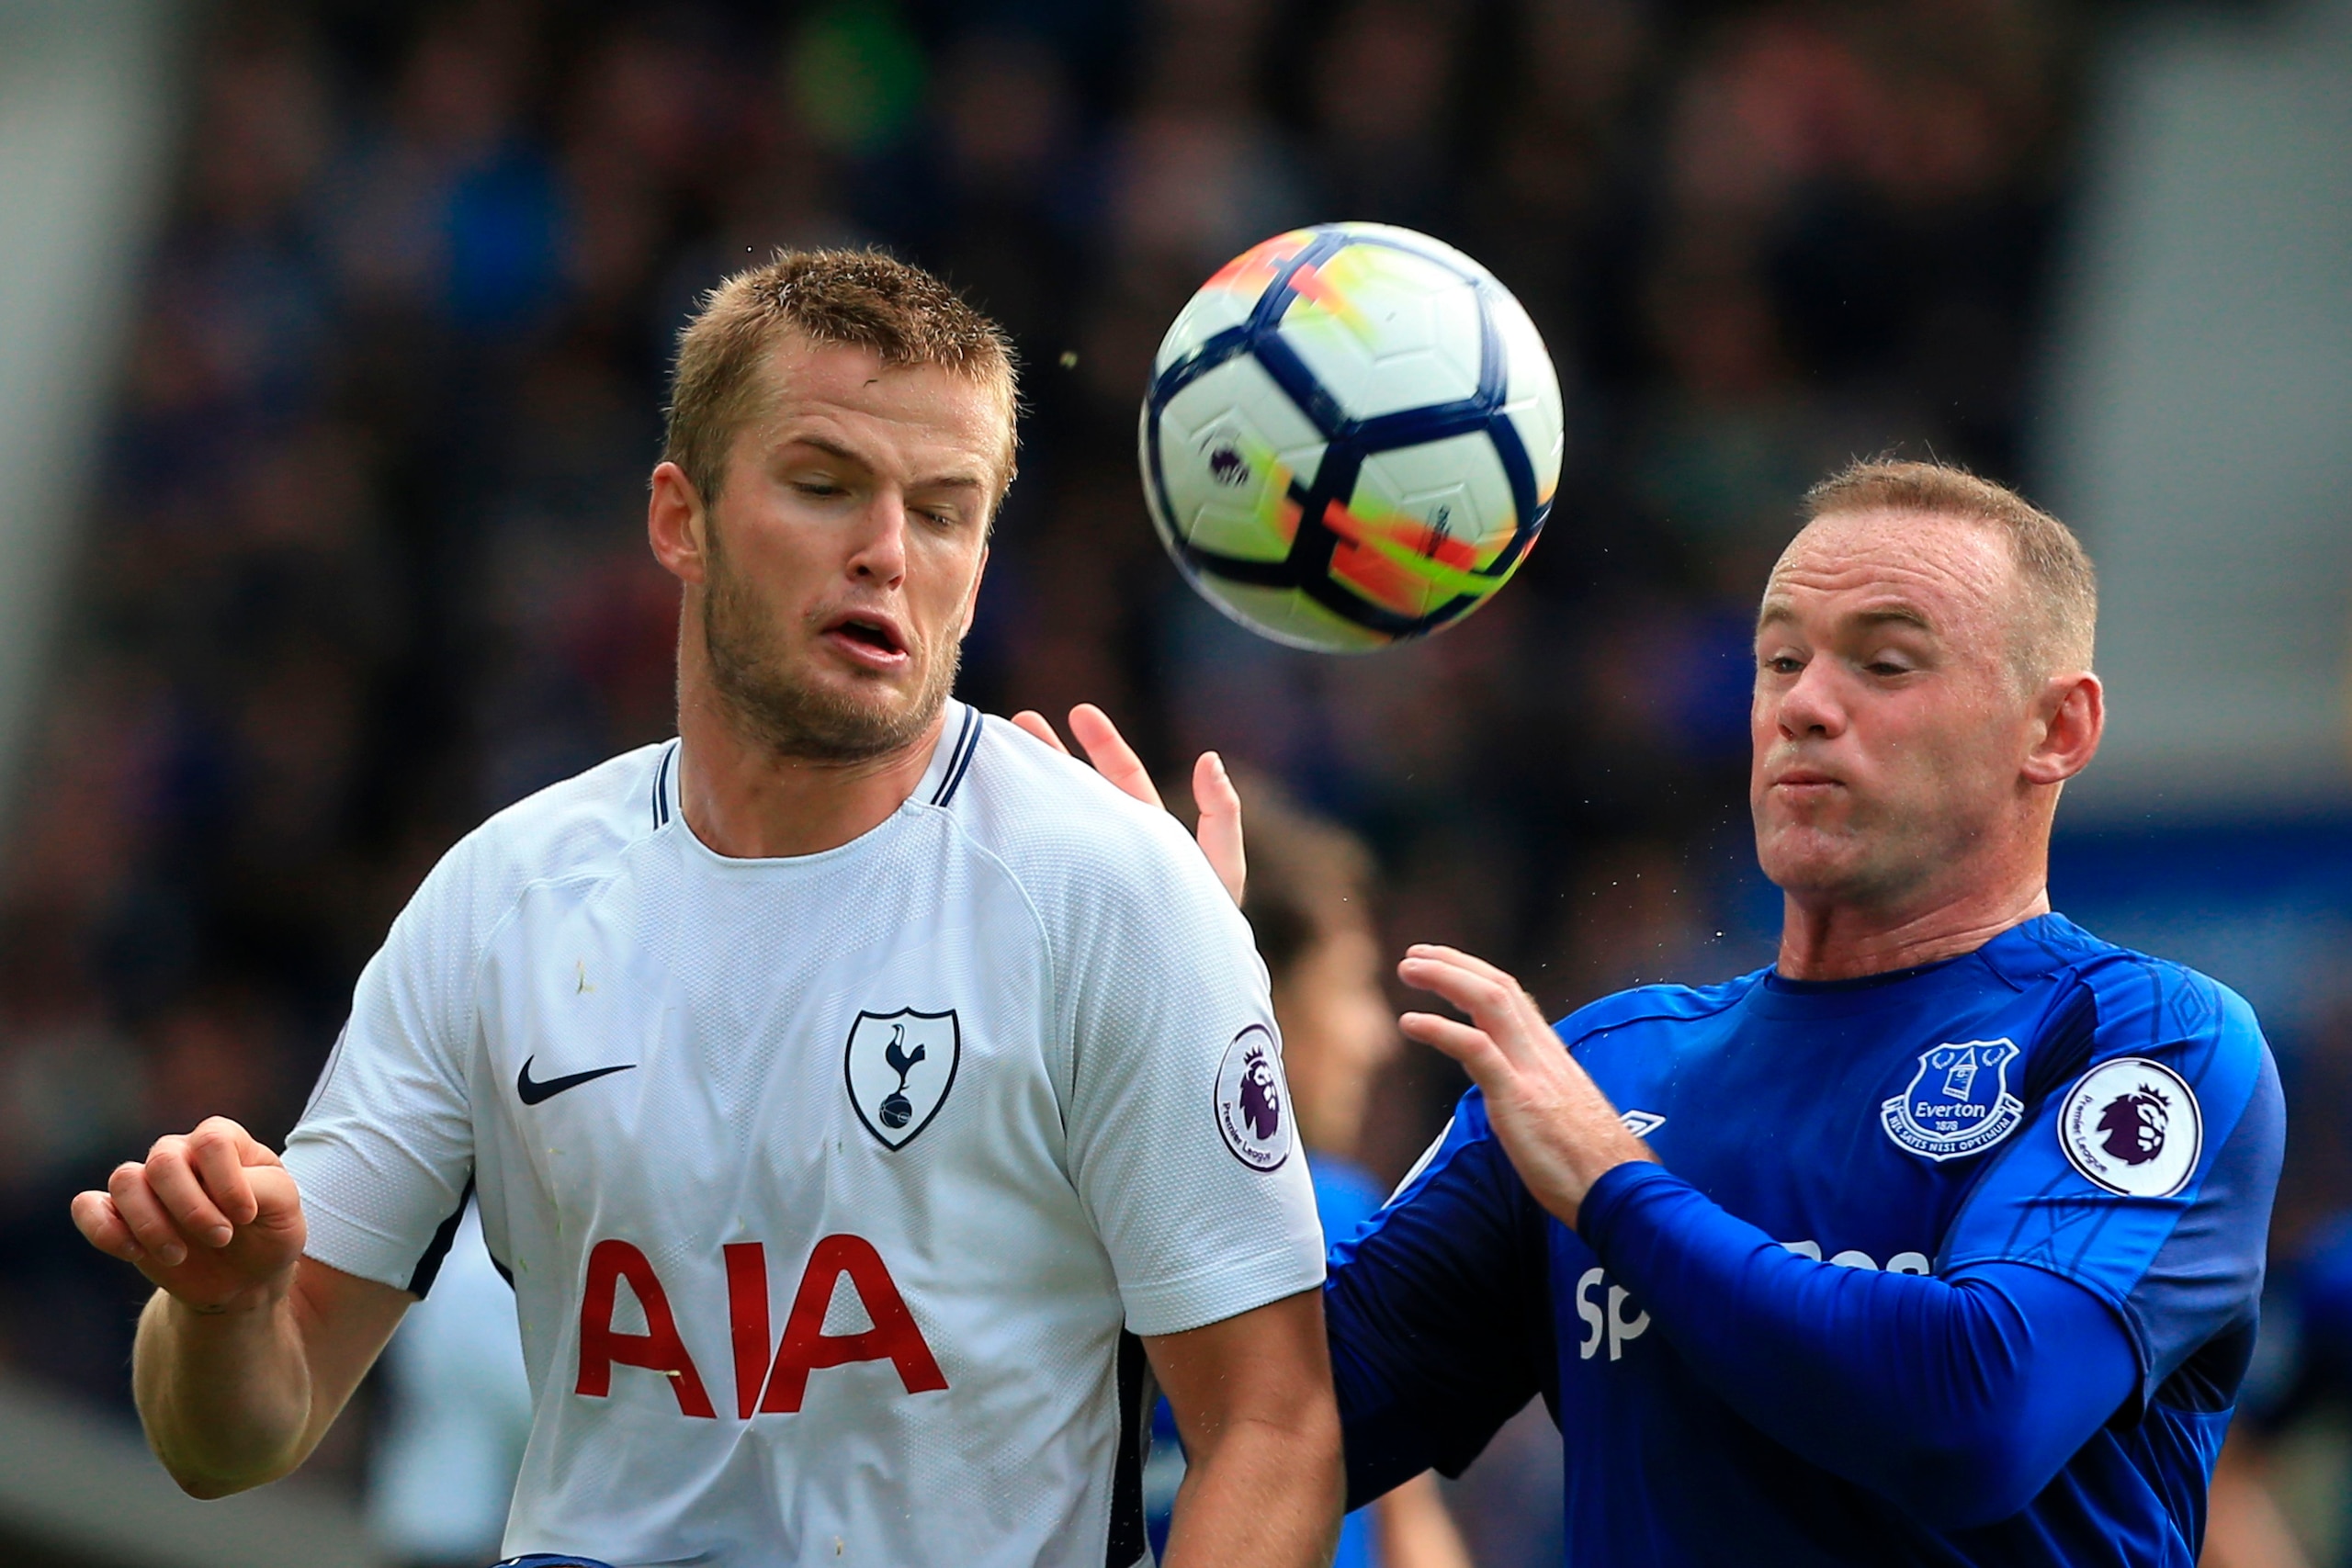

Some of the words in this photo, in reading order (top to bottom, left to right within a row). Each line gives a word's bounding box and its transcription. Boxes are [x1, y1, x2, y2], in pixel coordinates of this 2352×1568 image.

[1223, 1102, 1242, 1145] Premier
[1915, 1101, 1986, 1118] Everton
[1935, 1120, 1959, 1132] 1878
[2075, 1096, 2094, 1135] Premier
[1900, 1130, 1928, 1150] SATIS
[1928, 1143, 1956, 1153] NISI
[1959, 1117, 2011, 1150] OPTIMUM
[2075, 1135, 2109, 1174] League
[575, 1234, 950, 1420] AIA
